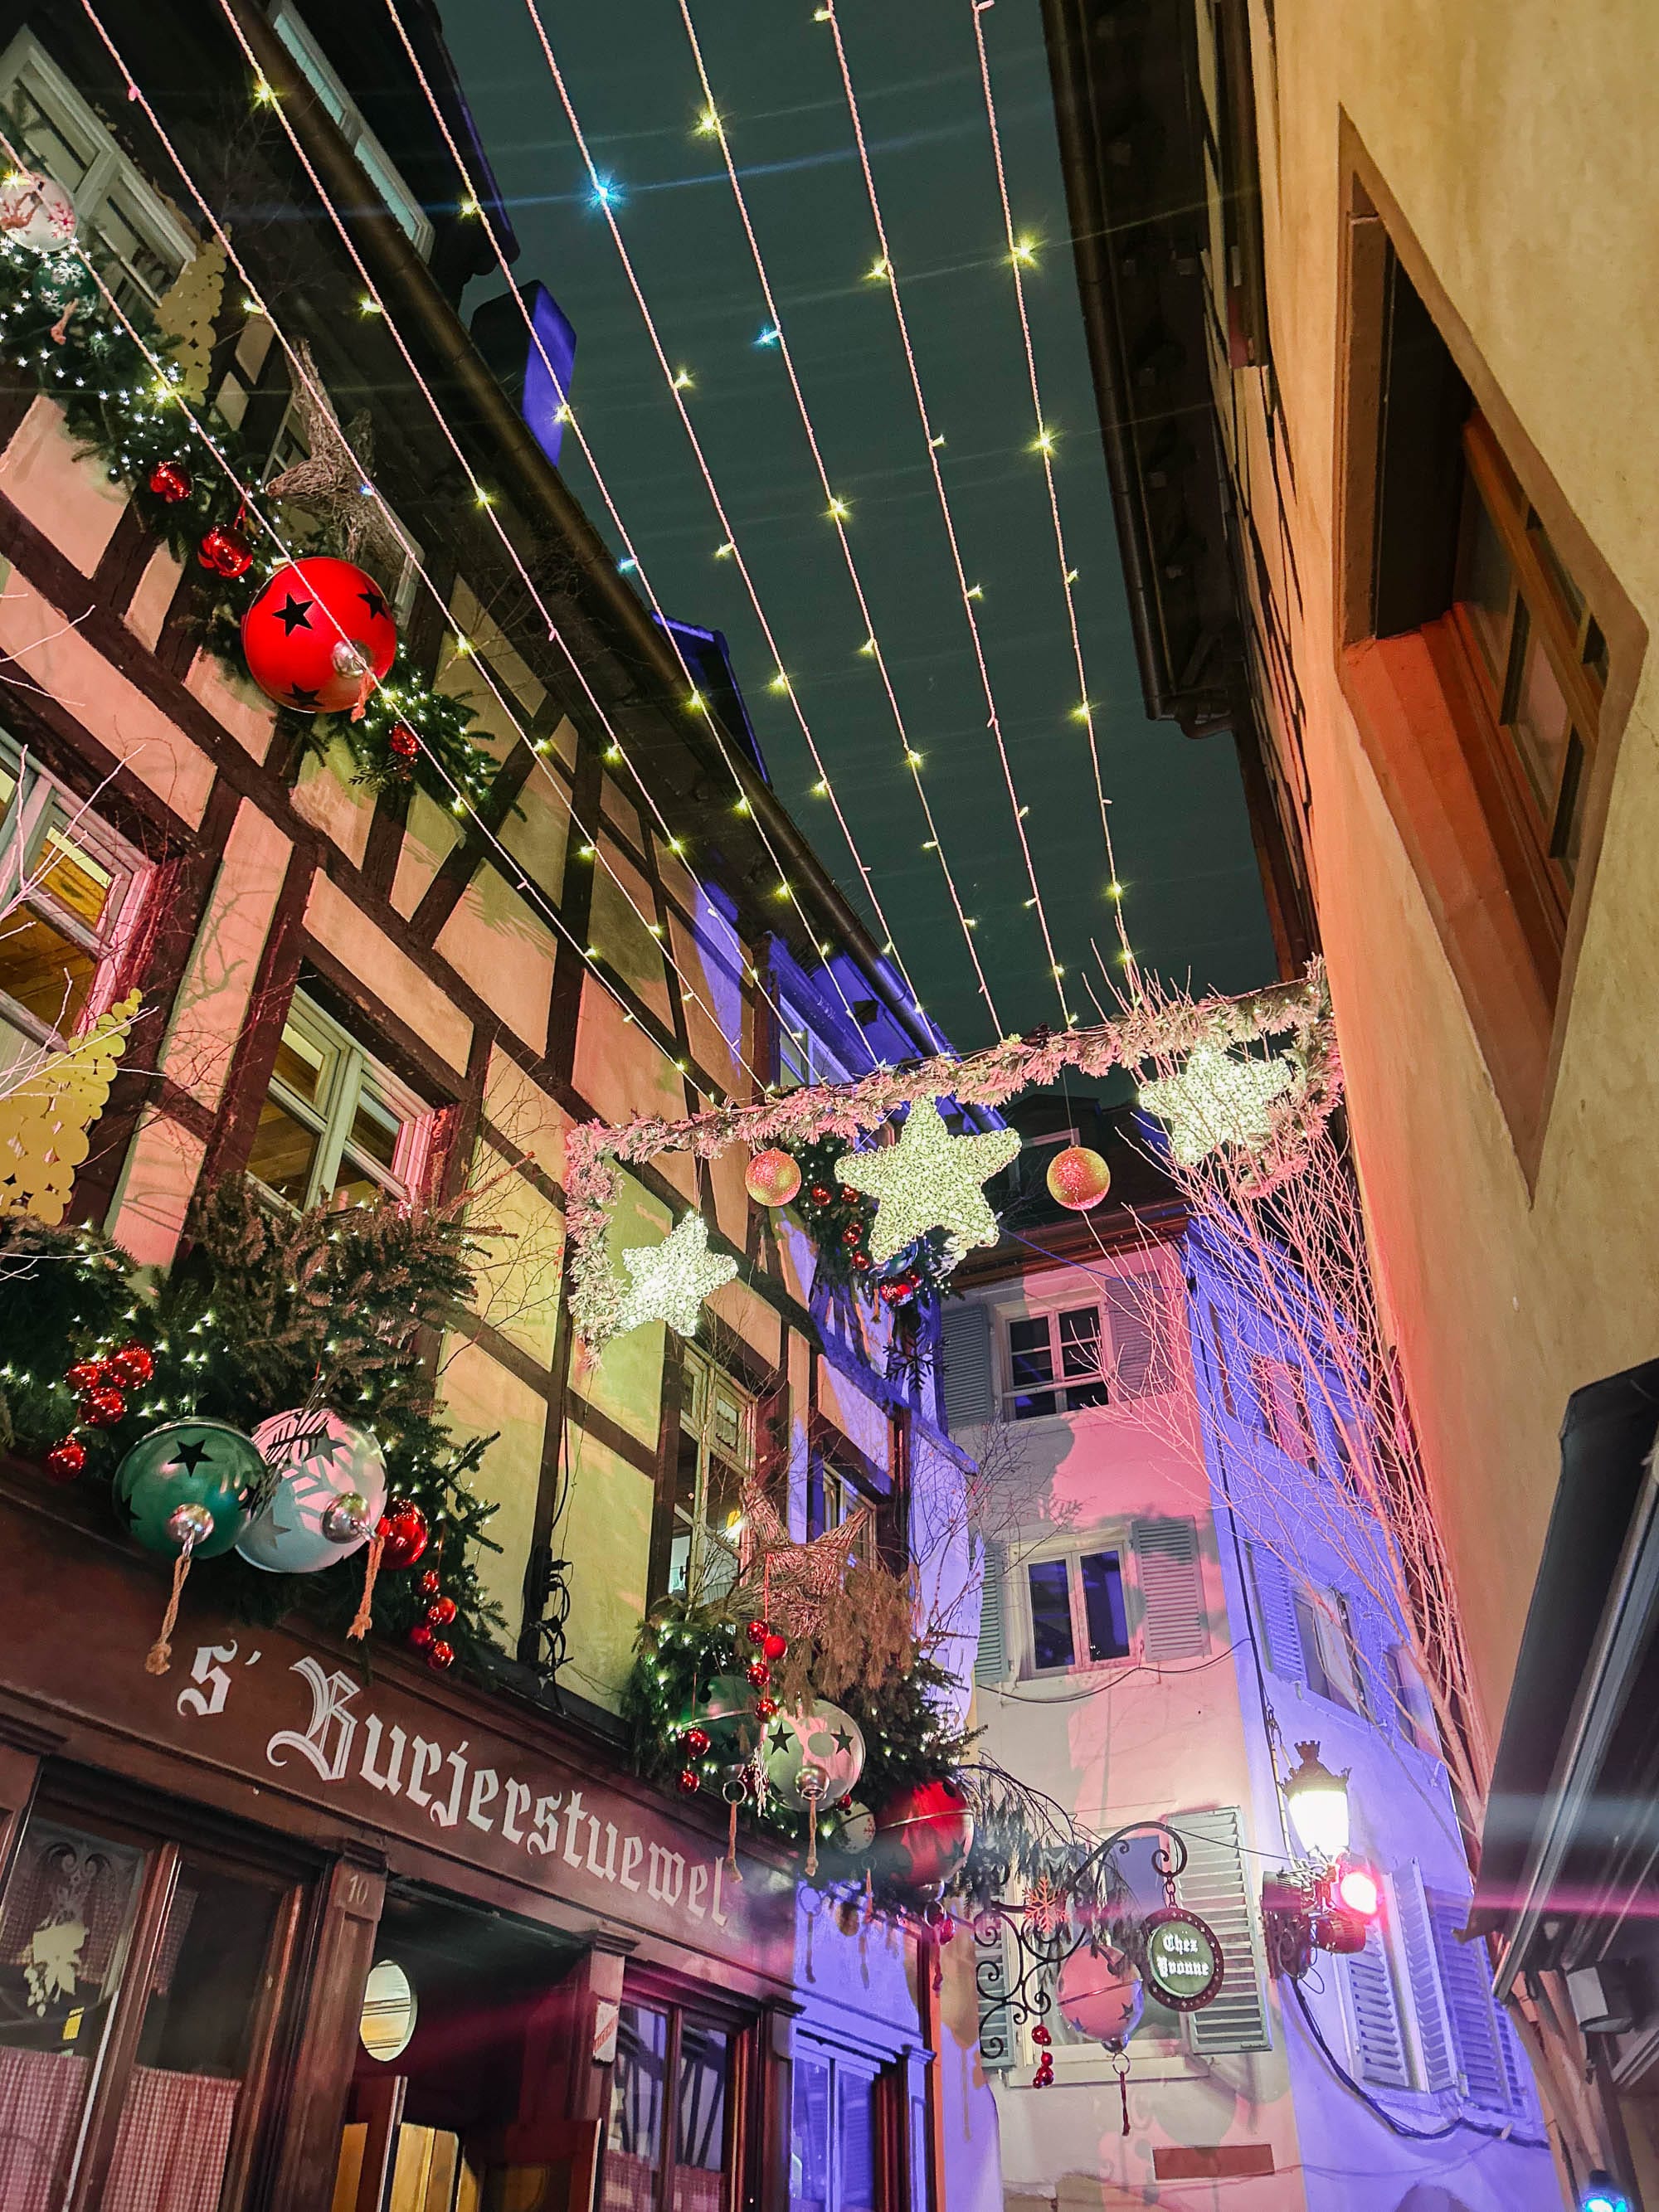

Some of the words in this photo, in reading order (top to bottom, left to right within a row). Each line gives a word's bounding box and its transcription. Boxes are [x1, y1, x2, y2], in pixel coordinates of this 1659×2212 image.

[348, 1874, 369, 1905] 10
[1163, 1932, 1199, 1955] Chez
[1156, 1956, 1209, 1978] Yvonne
